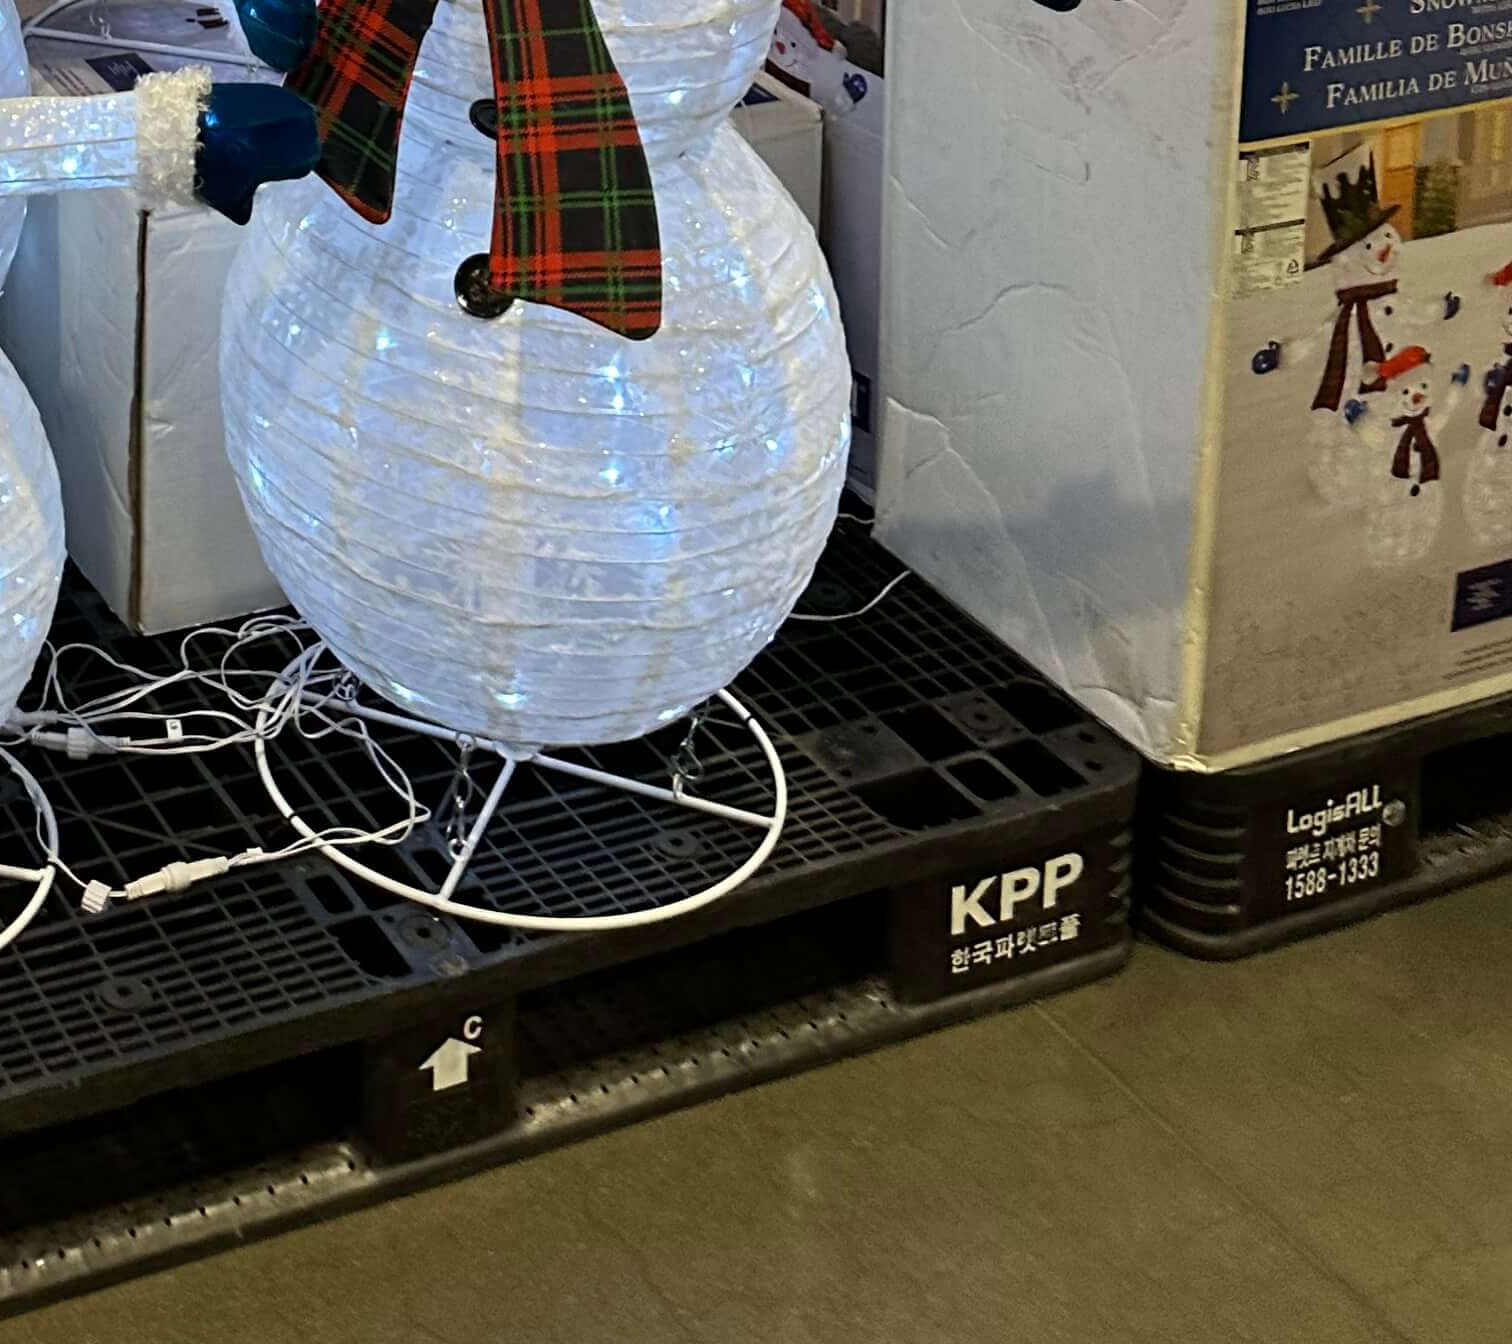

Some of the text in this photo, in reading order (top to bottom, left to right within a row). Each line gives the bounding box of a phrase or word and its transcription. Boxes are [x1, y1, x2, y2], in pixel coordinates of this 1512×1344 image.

[1304, 37, 1402, 73] FAMILLE
[1410, 33, 1439, 55] DE
[1326, 80, 1420, 109] FAMILIA
[1428, 69, 1457, 92] DE
[1286, 784, 1383, 837] LogisALL
[1358, 823, 1382, 852] 문의
[950, 852, 1084, 936] KPP
[1285, 851, 1380, 901] 1588-1333
[463, 1015, 483, 1040] C
